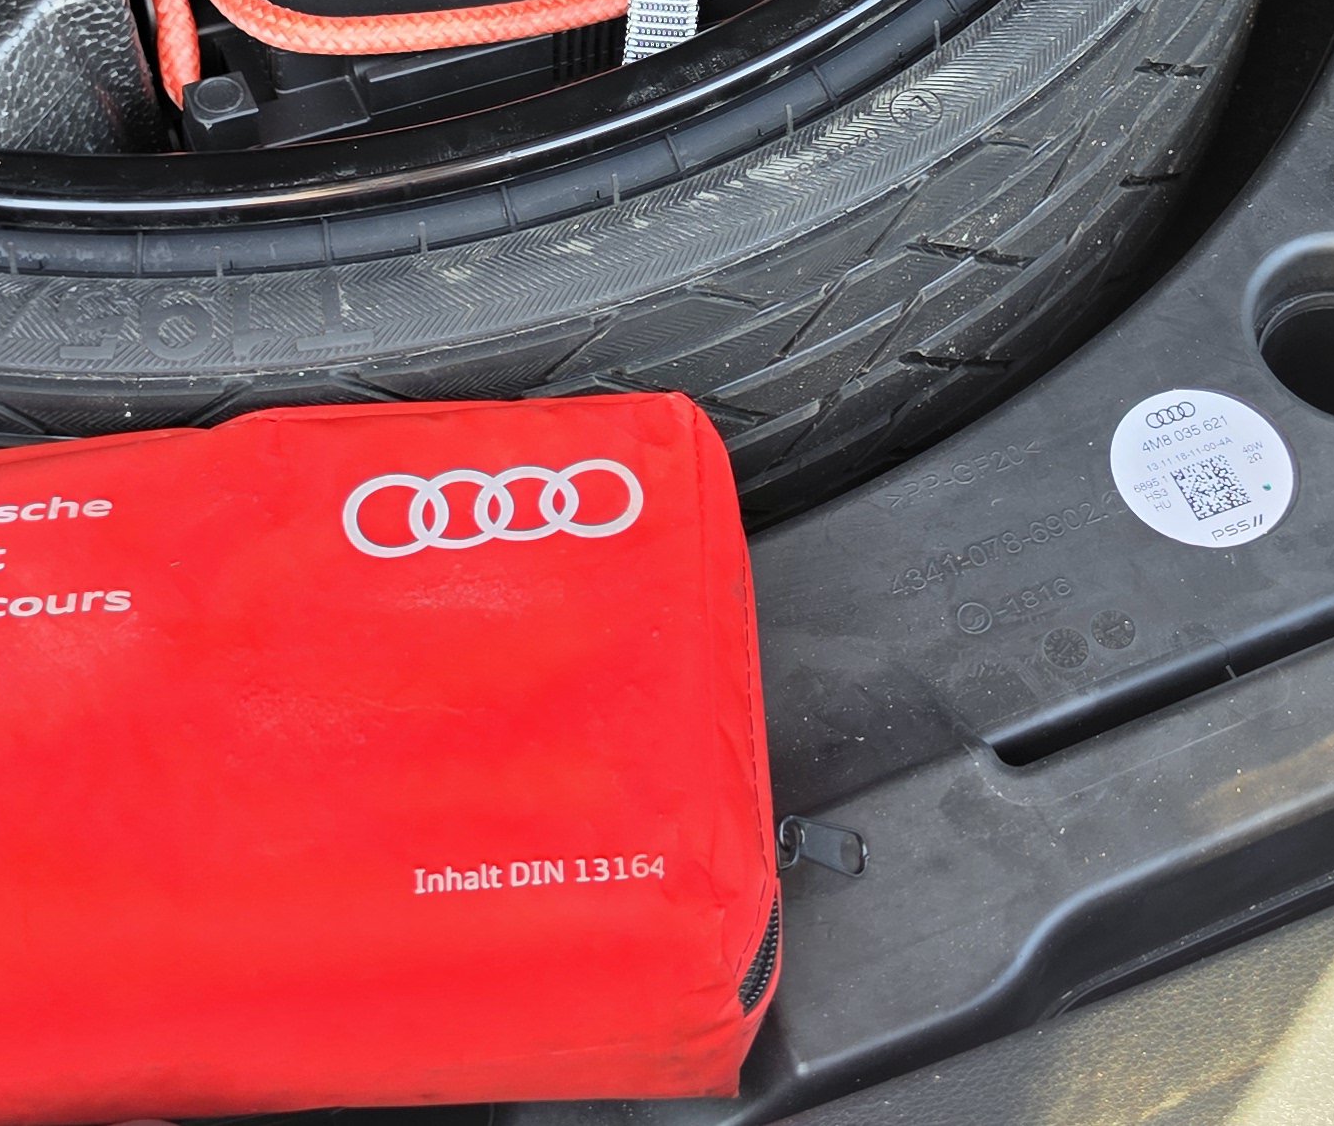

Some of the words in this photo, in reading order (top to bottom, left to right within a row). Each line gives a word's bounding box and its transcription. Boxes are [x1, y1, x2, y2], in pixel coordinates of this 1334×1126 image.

[1142, 435, 1172, 454] 4M8
[1174, 425, 1201, 442] 035
[1203, 415, 1229, 431] 621
[1242, 440, 1264, 455] 40W
[1247, 451, 1263, 465] 2Ω
[1145, 488, 1168, 502] HS3
[1154, 499, 1171, 511] HU
[414, 867, 503, 895] Inhalt
[510, 859, 565, 887] DIN
[575, 853, 667, 882] 13164
